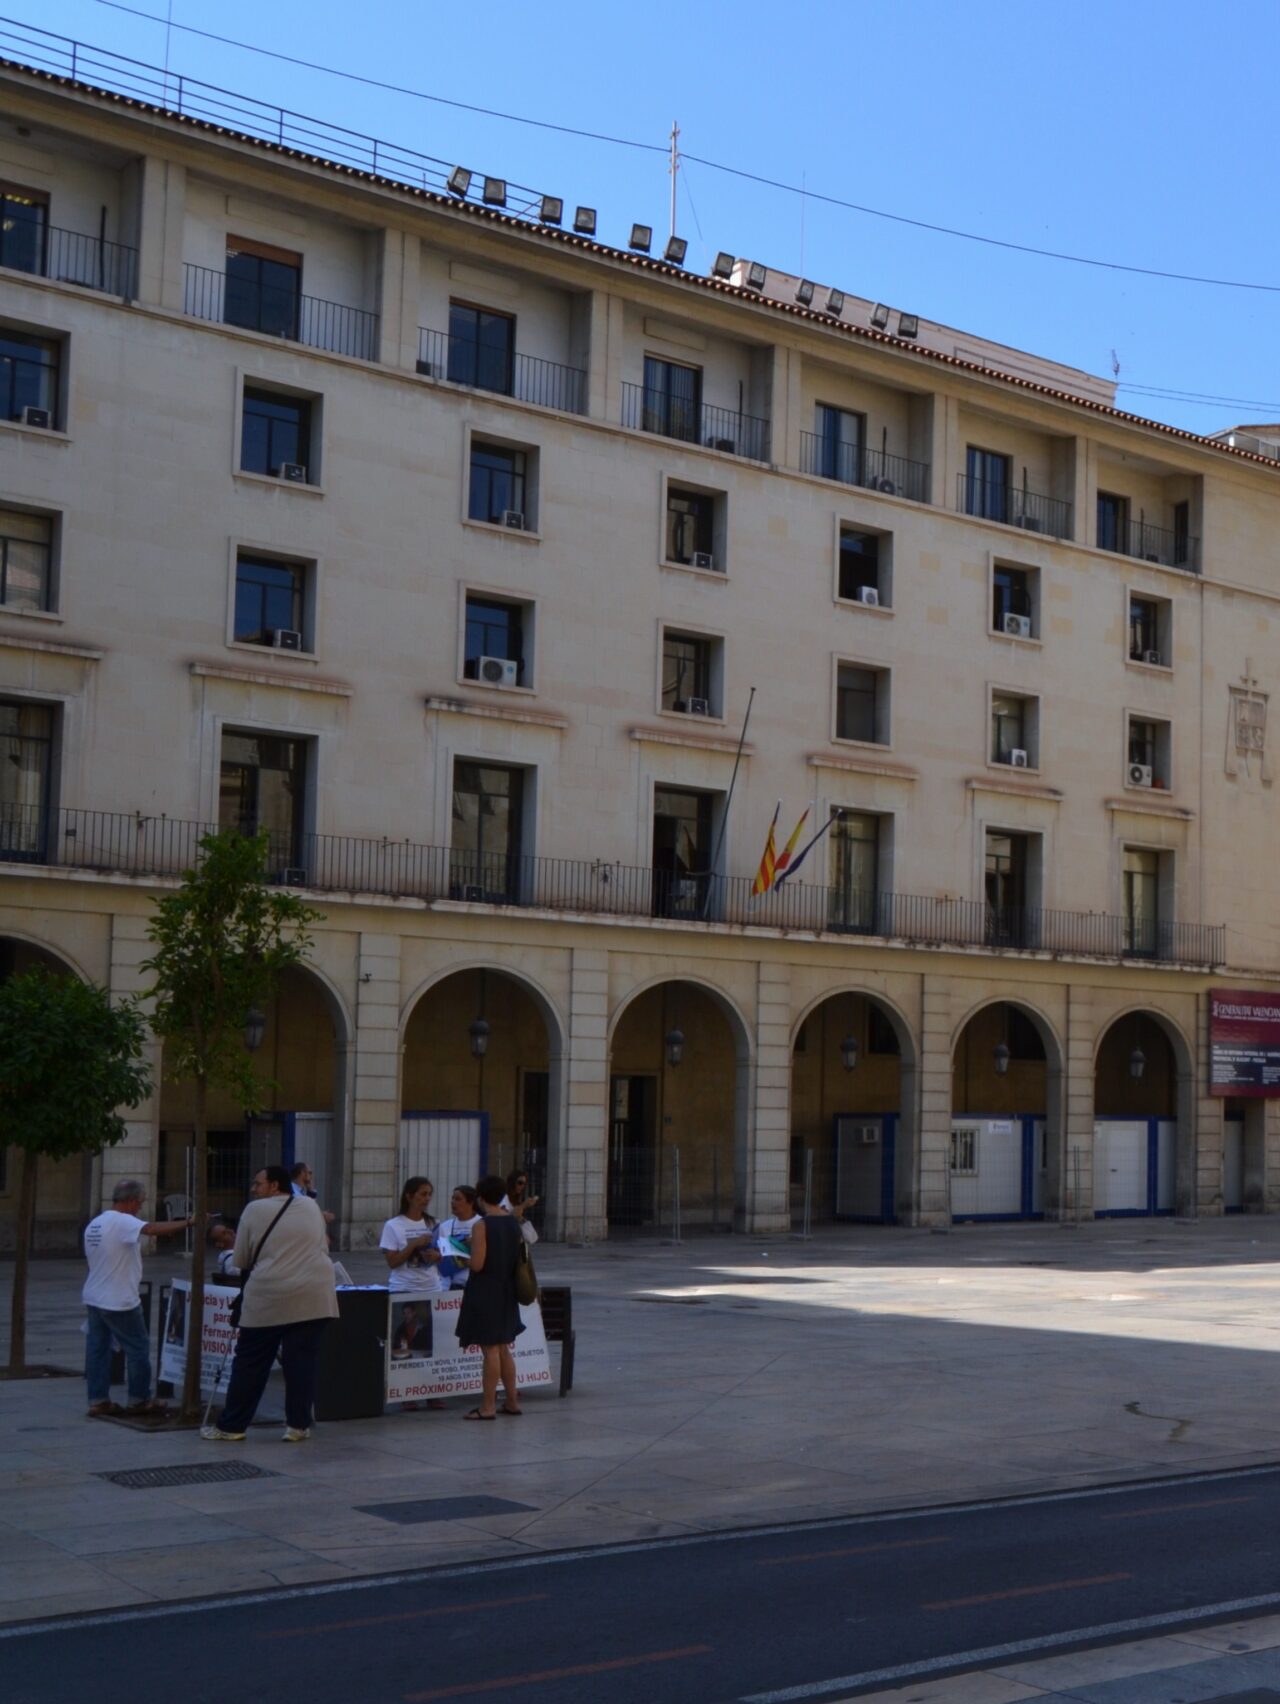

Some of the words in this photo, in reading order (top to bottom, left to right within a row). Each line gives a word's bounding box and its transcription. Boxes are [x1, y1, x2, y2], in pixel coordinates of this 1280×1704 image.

[1219, 1004, 1252, 1016] GENERALITAT
[398, 1361, 425, 1370] PIERDES
[517, 1348, 545, 1358] OBJETOS
[431, 1367, 440, 1375] DE
[389, 1388, 403, 1399] EL
[405, 1382, 454, 1396] PRÓXIMO
[455, 1380, 482, 1392] PUED
[527, 1371, 549, 1382] HIJO
